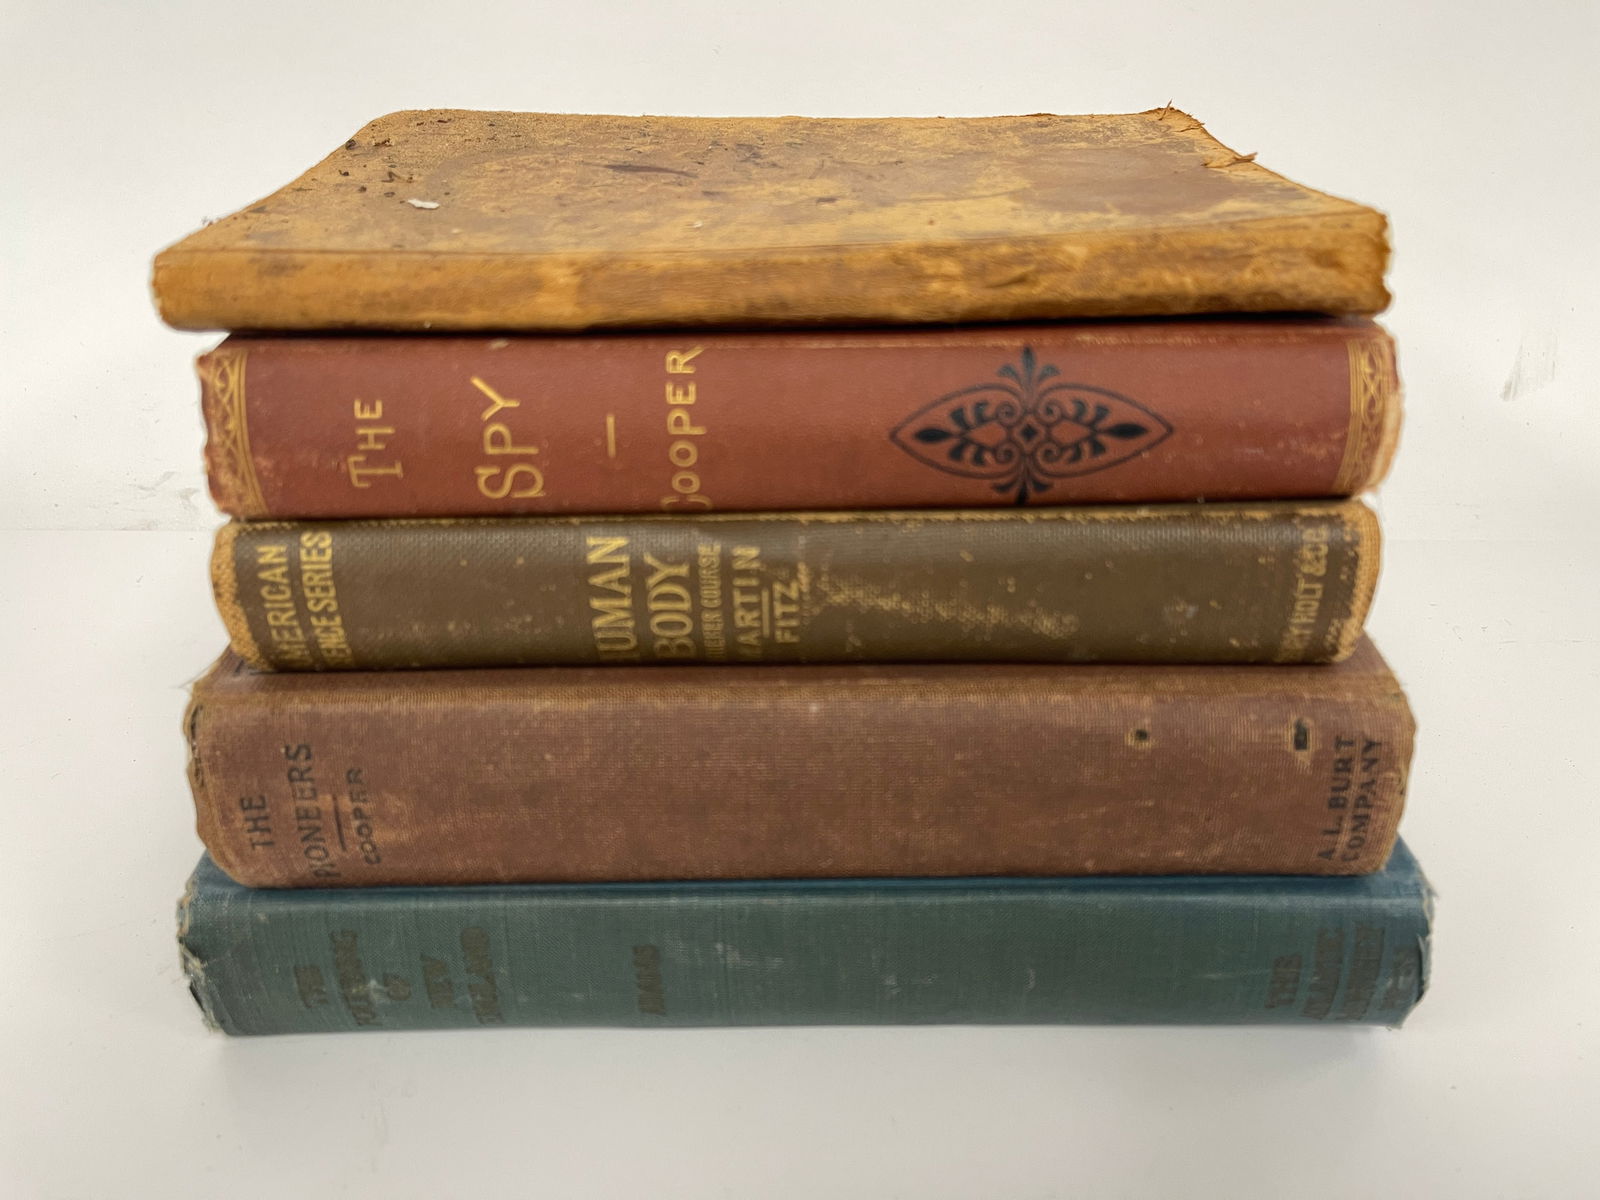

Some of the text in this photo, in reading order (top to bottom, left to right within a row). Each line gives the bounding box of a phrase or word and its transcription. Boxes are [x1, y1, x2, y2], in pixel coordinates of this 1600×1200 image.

[346, 399, 403, 489] THE
[470, 376, 545, 499] SPY
[256, 544, 310, 669] MERICAN
[301, 531, 354, 671] ENCE SERIES
[698, 541, 722, 608] COURSE
[346, 767, 382, 865] COOPER
[1327, 735, 1354, 810] BURT
[1340, 734, 1383, 862] COMPANY
[240, 794, 275, 851] THE
